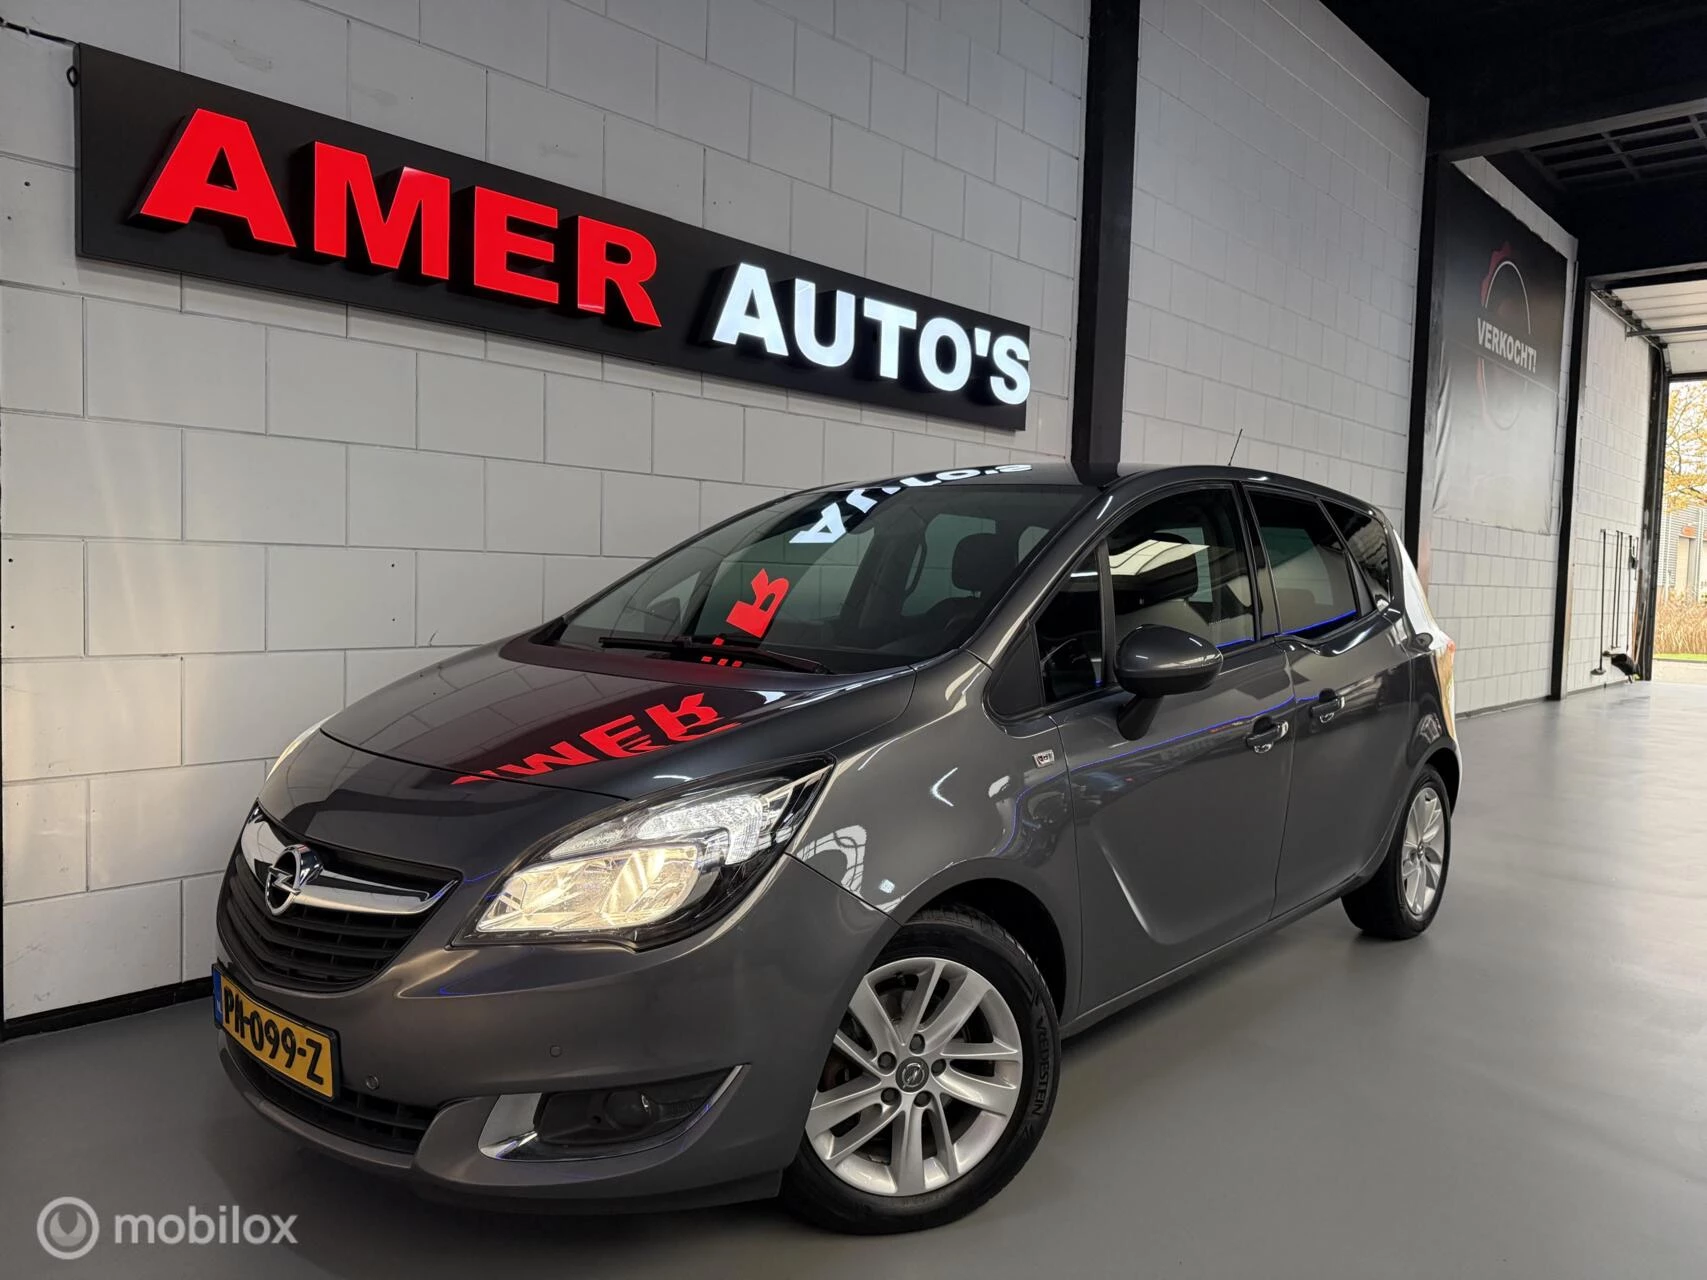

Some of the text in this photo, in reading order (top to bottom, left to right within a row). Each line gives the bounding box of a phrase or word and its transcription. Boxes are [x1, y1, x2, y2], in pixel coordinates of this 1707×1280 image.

[139, 107, 1031, 405] AMER AUTO'S
[1477, 317, 1537, 374] VERKOCHT!
[1032, 1016, 1050, 1117] VREDESTEIN
